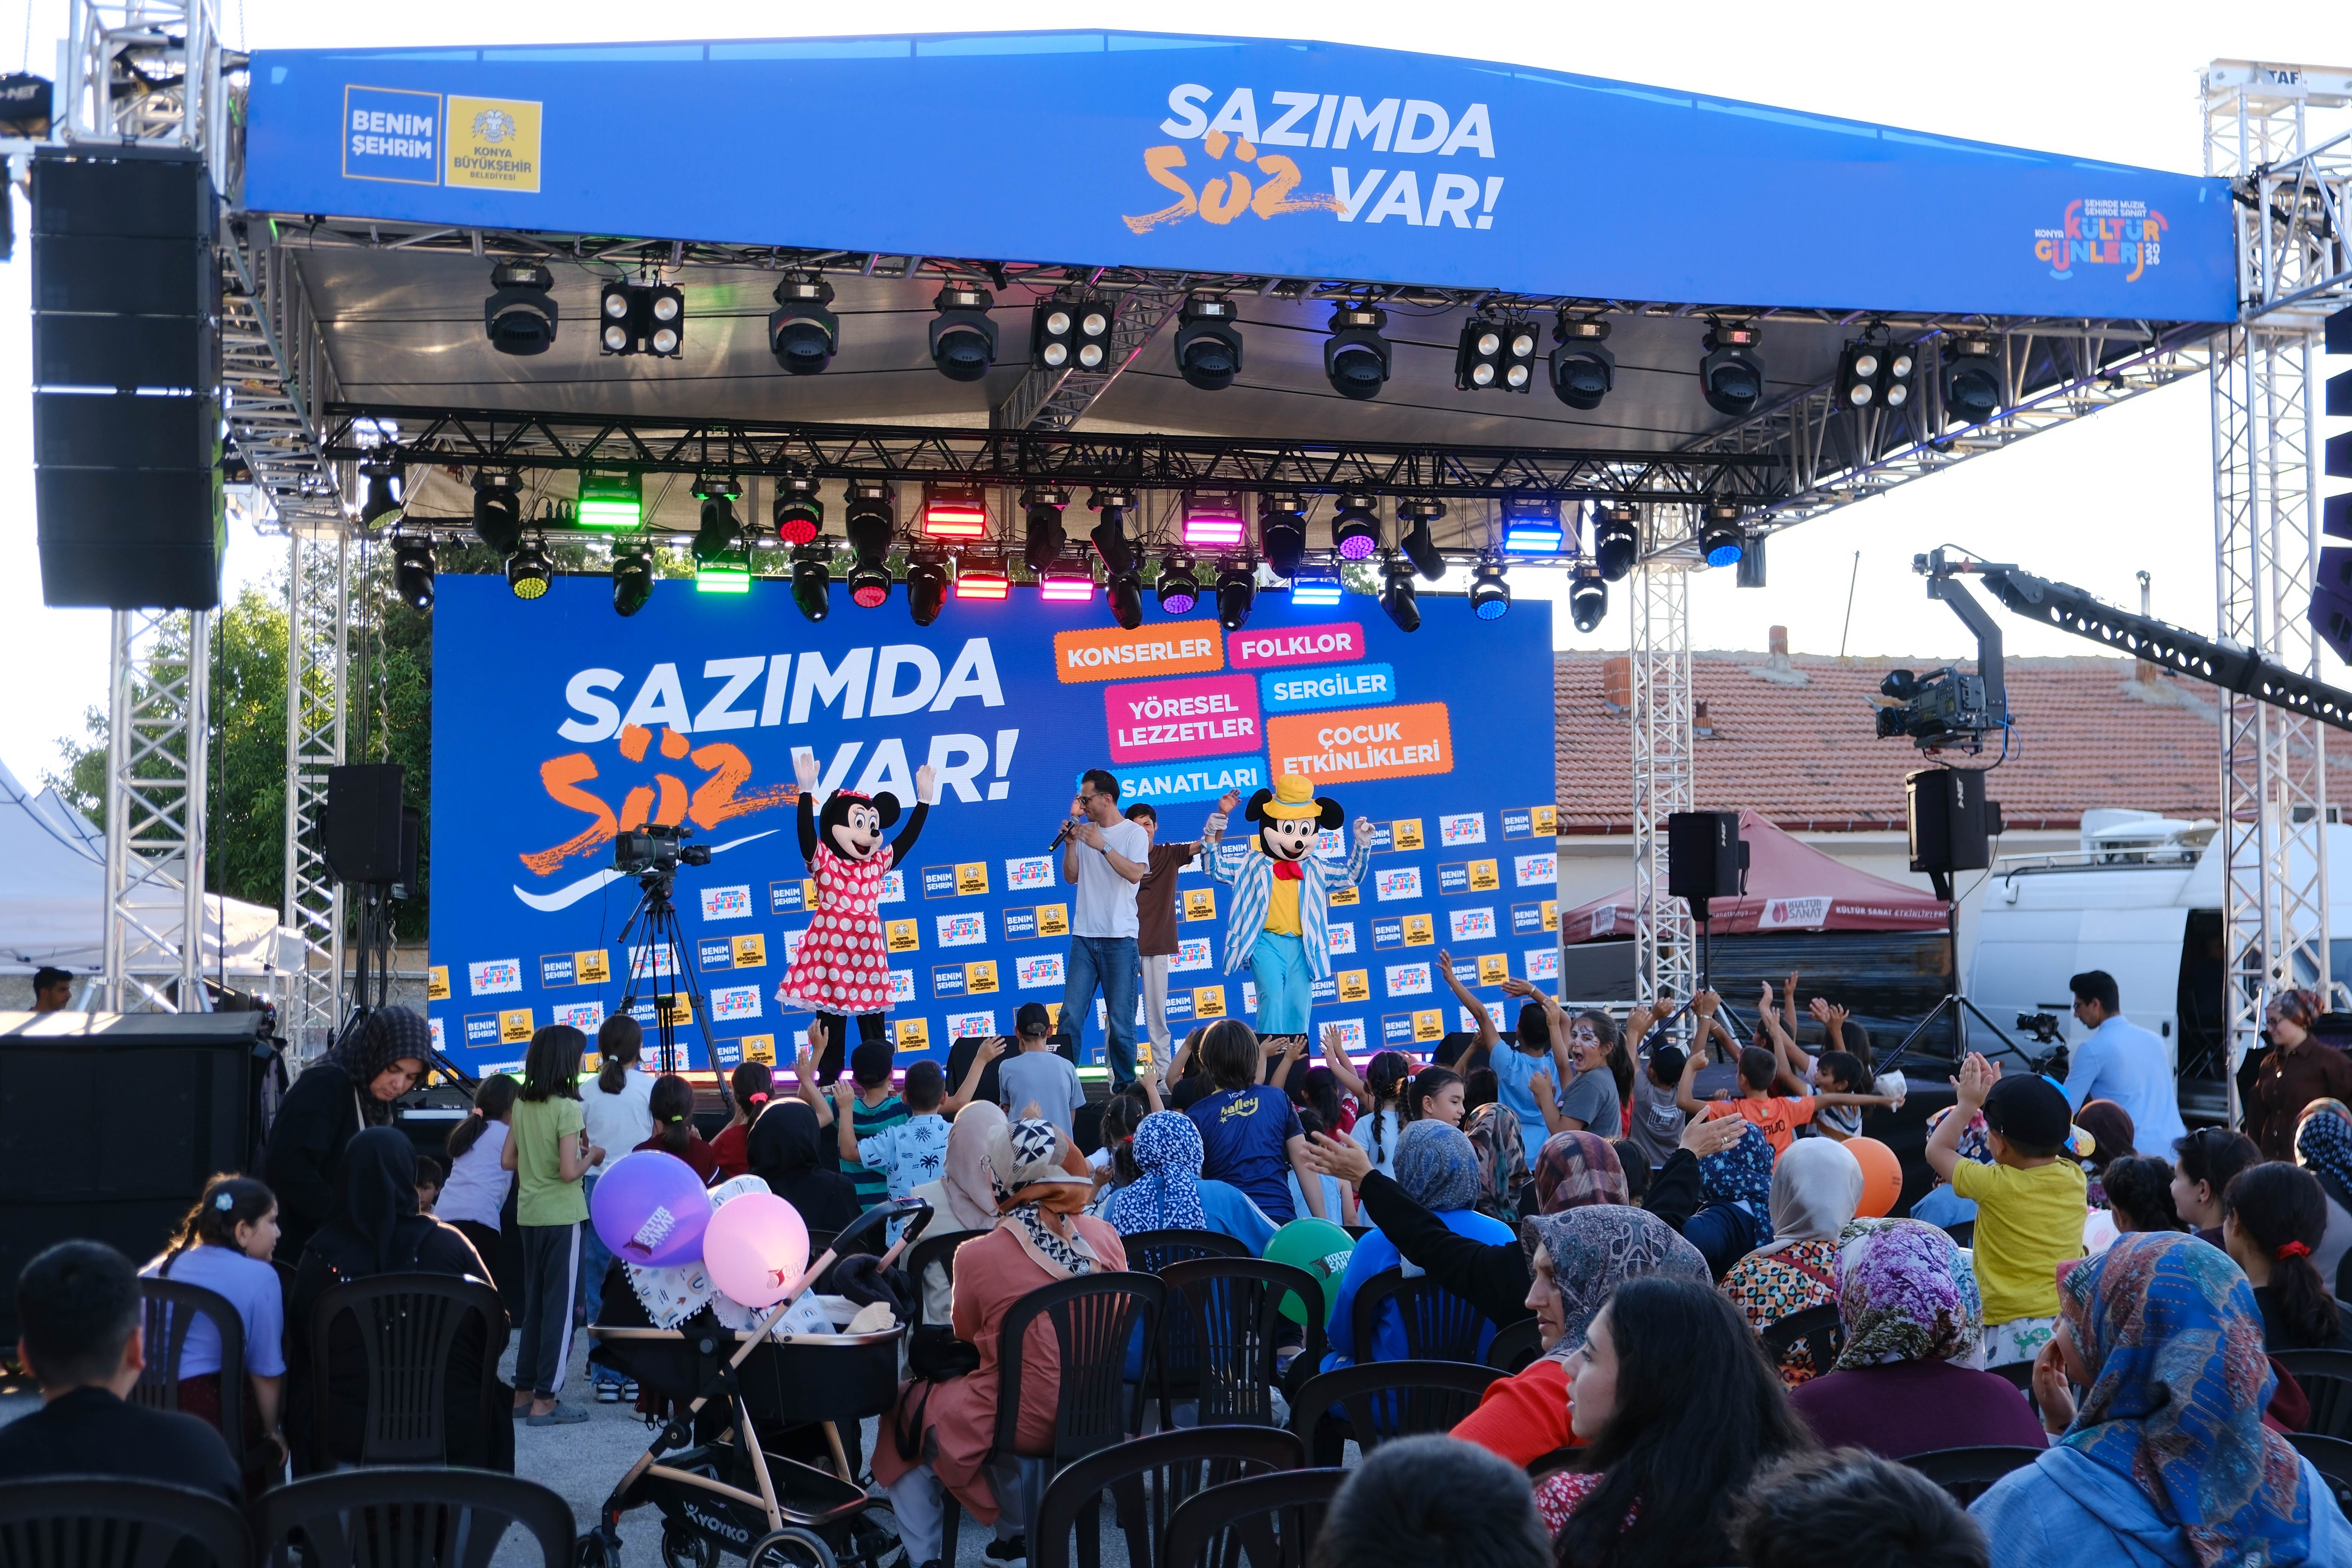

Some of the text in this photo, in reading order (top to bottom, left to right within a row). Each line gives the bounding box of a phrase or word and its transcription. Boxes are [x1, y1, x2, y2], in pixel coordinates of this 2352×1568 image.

[353, 110, 432, 136] BENİM
[1160, 83, 1495, 158] SAZIMDA
[352, 135, 432, 159] ŞEHRİM
[474, 146, 512, 158] KONYA
[454, 156, 531, 173] BÜYÜKŞEHİR
[470, 171, 516, 181] BELEDİYESİ
[1332, 167, 1504, 230] VAR!
[2035, 229, 2064, 239] KONYA
[1242, 633, 1352, 660] FOLKLOR
[1068, 639, 1212, 668] KONSERLER
[557, 637, 1005, 743] SAZIMDA
[1274, 672, 1387, 701] SERGİLER
[1129, 694, 1239, 720] YÖRESEL
[1119, 719, 1254, 747] LEZZETLER
[1318, 722, 1401, 750] ÇOCUK
[1283, 740, 1440, 774] ETKİNLİKLERİ
[1122, 768, 1258, 798] SANATLARI
[1504, 816, 1528, 825] BENİM
[1373, 828, 1390, 838] ENİM
[1505, 824, 1529, 833] ŞEHRİM
[1370, 836, 1391, 846] EHRİM
[1222, 844, 1248, 853] BENİM
[926, 873, 952, 882] BENİM
[1441, 870, 1465, 879] BENİM
[927, 882, 953, 891] ŞEHRİM
[1441, 878, 1465, 887] ŞEHRİM
[773, 888, 800, 897] BENİM
[774, 896, 801, 906] ŞEHRİM
[1514, 910, 1538, 919] BENİM
[1789, 909, 1822, 919] SANAT
[1836, 905, 1866, 915] KÜLTÜR
[1868, 907, 1892, 916] SANAT
[1007, 915, 1033, 924] BENİM
[1514, 918, 1539, 927] ŞEHRİM
[1008, 923, 1034, 933] ŞEHRİM
[1375, 925, 1400, 934] BENİM
[1375, 933, 1400, 942] ŞEHRİM
[702, 945, 729, 955] BENİM
[703, 954, 729, 964] ŞEHRİM
[544, 961, 572, 971] BENİM
[1453, 963, 1476, 973] BENİM
[545, 970, 573, 980] ŞEHRİM
[936, 972, 962, 981] BENİM
[936, 980, 963, 990] ŞEHRİM
[1312, 981, 1335, 990] BENİM
[1312, 989, 1336, 999] ŞEHRİM
[1166, 997, 1191, 1006] BENİM
[628, 1004, 655, 1014] BENİM
[468, 1020, 496, 1030] BENİM
[1385, 1020, 1410, 1029] BENİM
[469, 1029, 497, 1039] ŞEHRİM
[1386, 1029, 1410, 1038] ŞEHRİM
[1221, 1097, 1259, 1116] halley
[643, 1214, 675, 1248] SANAT
[1329, 1258, 1348, 1273] SAN
